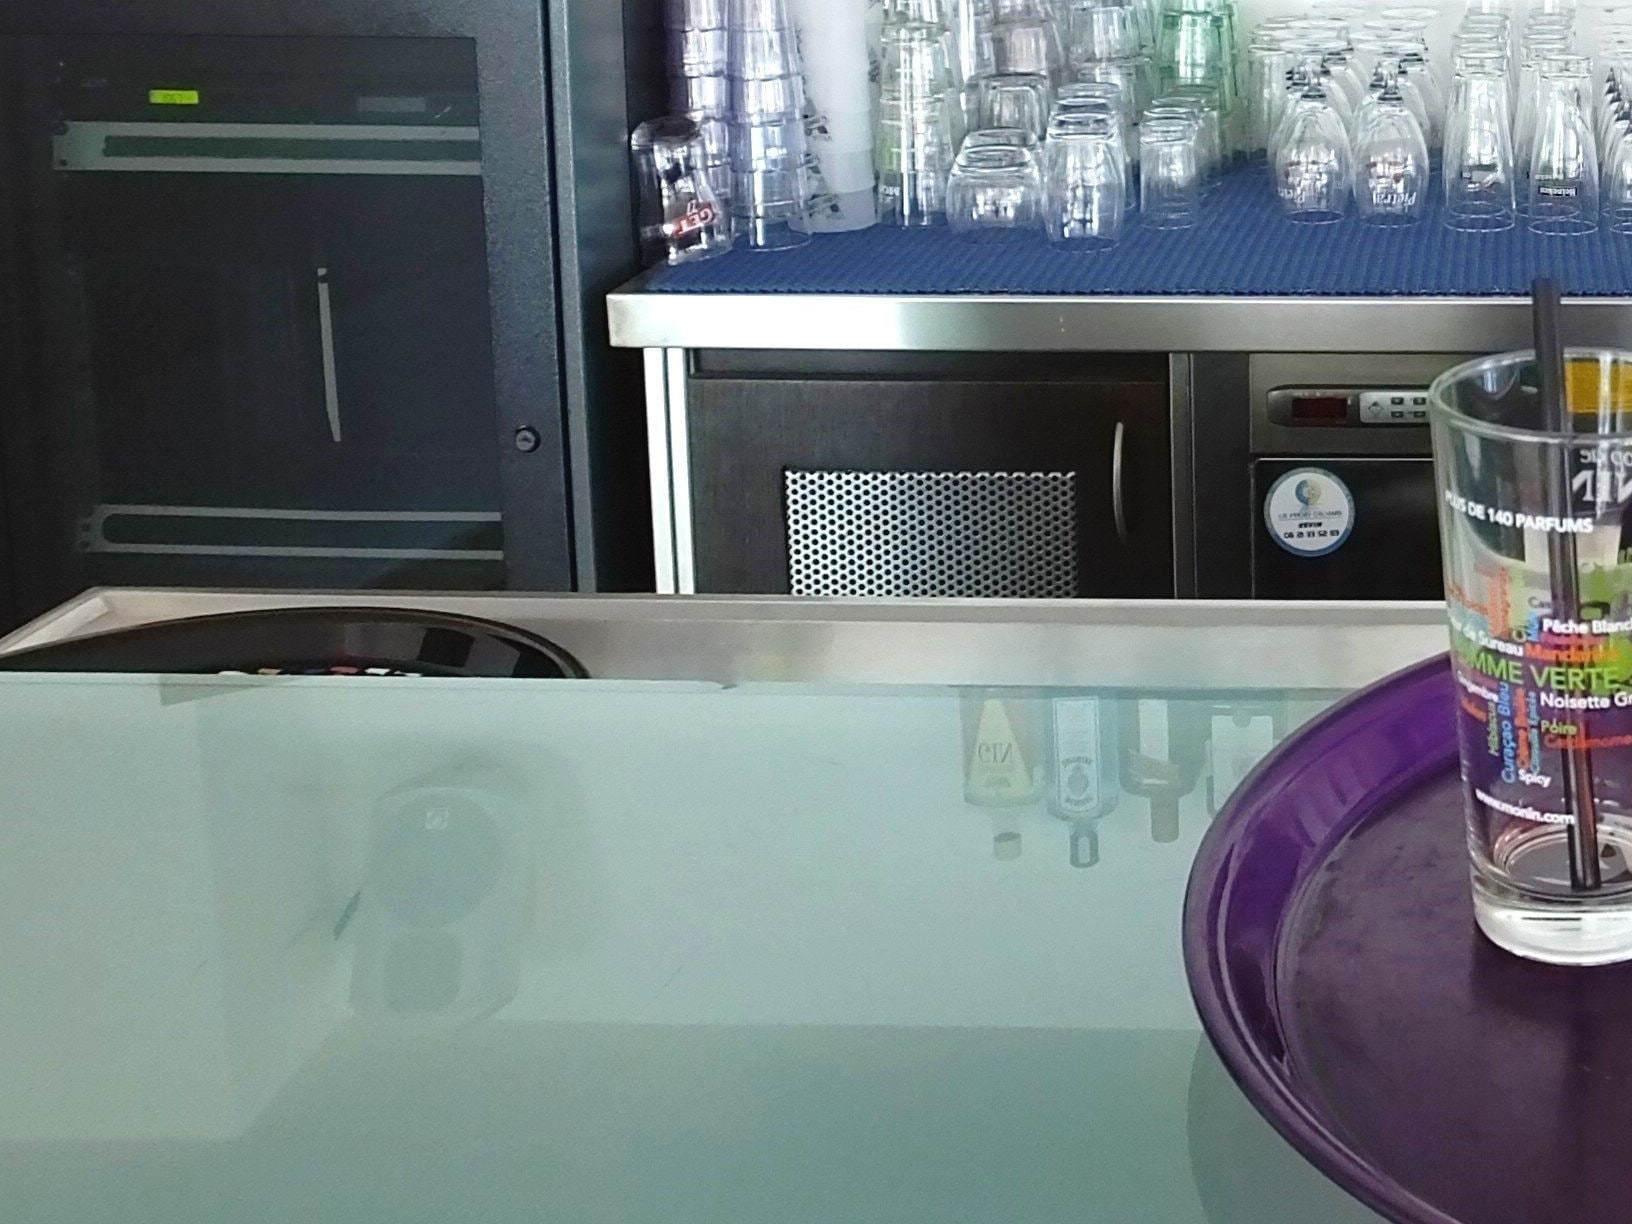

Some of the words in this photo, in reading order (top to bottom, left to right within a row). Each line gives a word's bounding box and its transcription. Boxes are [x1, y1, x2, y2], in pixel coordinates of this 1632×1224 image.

[1467, 501, 1486, 520] DE
[1487, 507, 1513, 528] 140
[1515, 513, 1594, 534] PARFUMS
[1542, 616, 1588, 635] Pêche
[1529, 664, 1620, 691] VERTE
[1539, 691, 1611, 710] Noisette
[1501, 720, 1516, 784] Curaçao
[1518, 768, 1553, 789] Spicy
